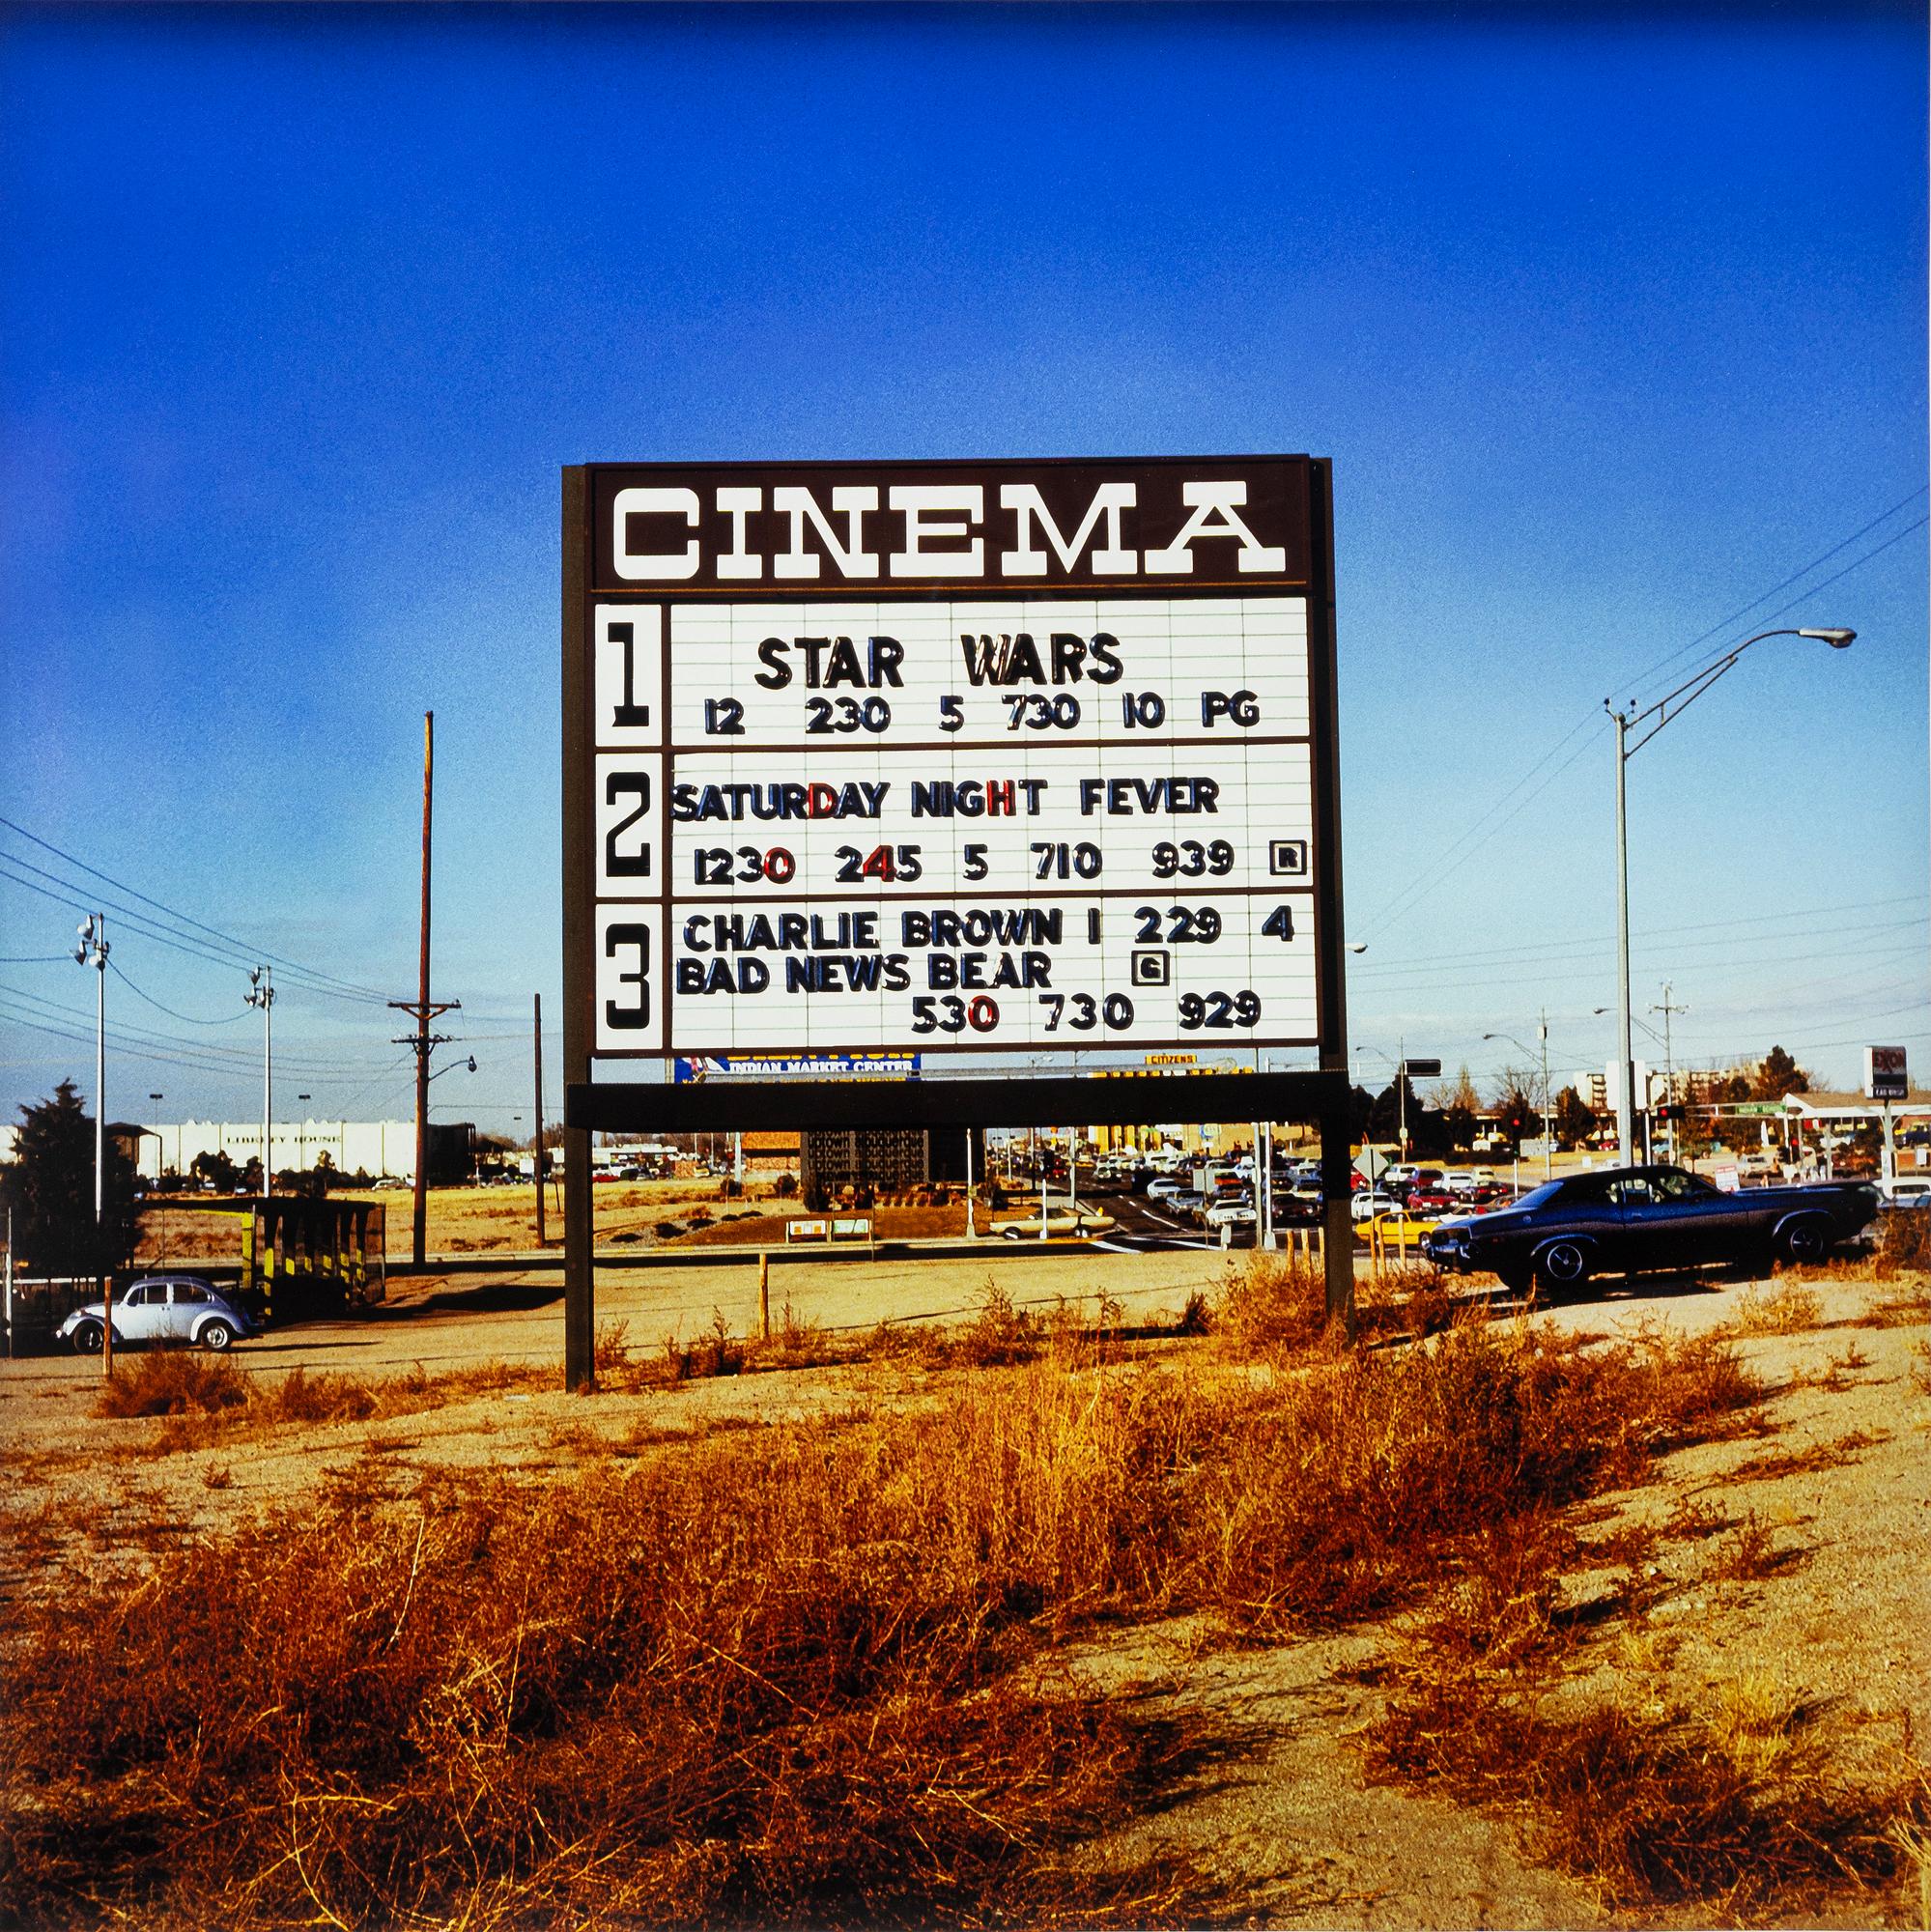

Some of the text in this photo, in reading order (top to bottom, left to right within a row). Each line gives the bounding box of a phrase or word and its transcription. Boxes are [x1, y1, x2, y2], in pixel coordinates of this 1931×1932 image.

[612, 480, 1287, 580] CINEMA
[607, 621, 650, 727] 1
[753, 632, 1124, 691] STAR WARS
[705, 692, 1261, 736] 12 230 5 730 10 PG
[670, 776, 1220, 822] SATURDAY NIGHT FEVER
[606, 771, 651, 878] 2
[695, 838, 1298, 886] 1230 245 5 710 939 R
[683, 911, 880, 952] CHARLIE
[901, 907, 1064, 948] BROWN
[1133, 905, 1222, 945] 229
[1262, 905, 1295, 943] 4
[605, 923, 650, 1030] 3
[676, 956, 771, 995] BAD
[785, 953, 911, 994] NEWS
[927, 951, 1052, 991] BEAR
[911, 990, 1262, 1035] 530 730 929
[729, 1060, 914, 1073] INDIAN MARKET CENTER
[1150, 1055, 1194, 1065] CITIZENS
[855, 1135, 924, 1150] abuquerque
